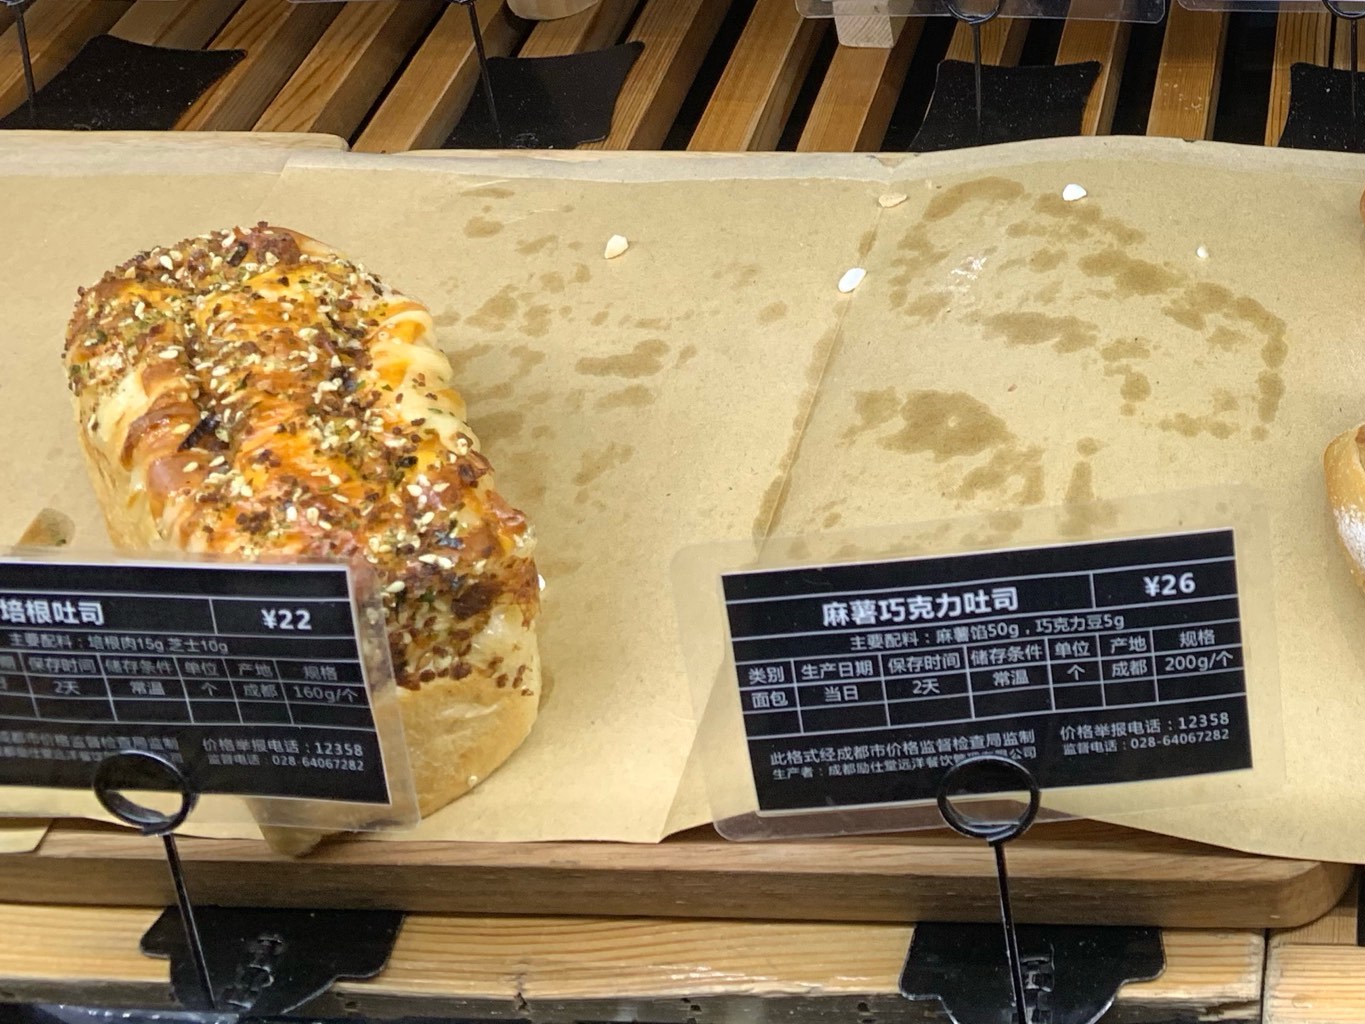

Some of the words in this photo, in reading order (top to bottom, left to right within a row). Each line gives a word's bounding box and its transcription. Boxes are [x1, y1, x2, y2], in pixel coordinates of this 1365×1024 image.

[1143, 572, 1196, 597] ¥26
[260, 608, 313, 630] ¥22
[820, 585, 1019, 628] 麻薯巧克力吐司
[747, 665, 785, 685] 类别
[800, 658, 874, 681] 生产日期
[886, 652, 961, 674] 保存时间
[969, 643, 1043, 666] 储存条件
[1053, 639, 1090, 659] 单位
[1109, 634, 1147, 654] 产地
[1178, 627, 1216, 649] 规格
[302, 664, 338, 681] 规格
[751, 689, 789, 708] 面包
[823, 683, 859, 702] 当日
[910, 677, 940, 695] 2天
[991, 668, 1029, 687] 常温
[1066, 663, 1086, 681] 个
[1110, 658, 1148, 677] 成都
[1164, 650, 1234, 674] 200g/个
[50, 676, 81, 695] 2天
[128, 680, 165, 695] 常温
[200, 682, 219, 696] 个
[242, 684, 279, 698] 成都
[293, 686, 360, 704] 160g/个
